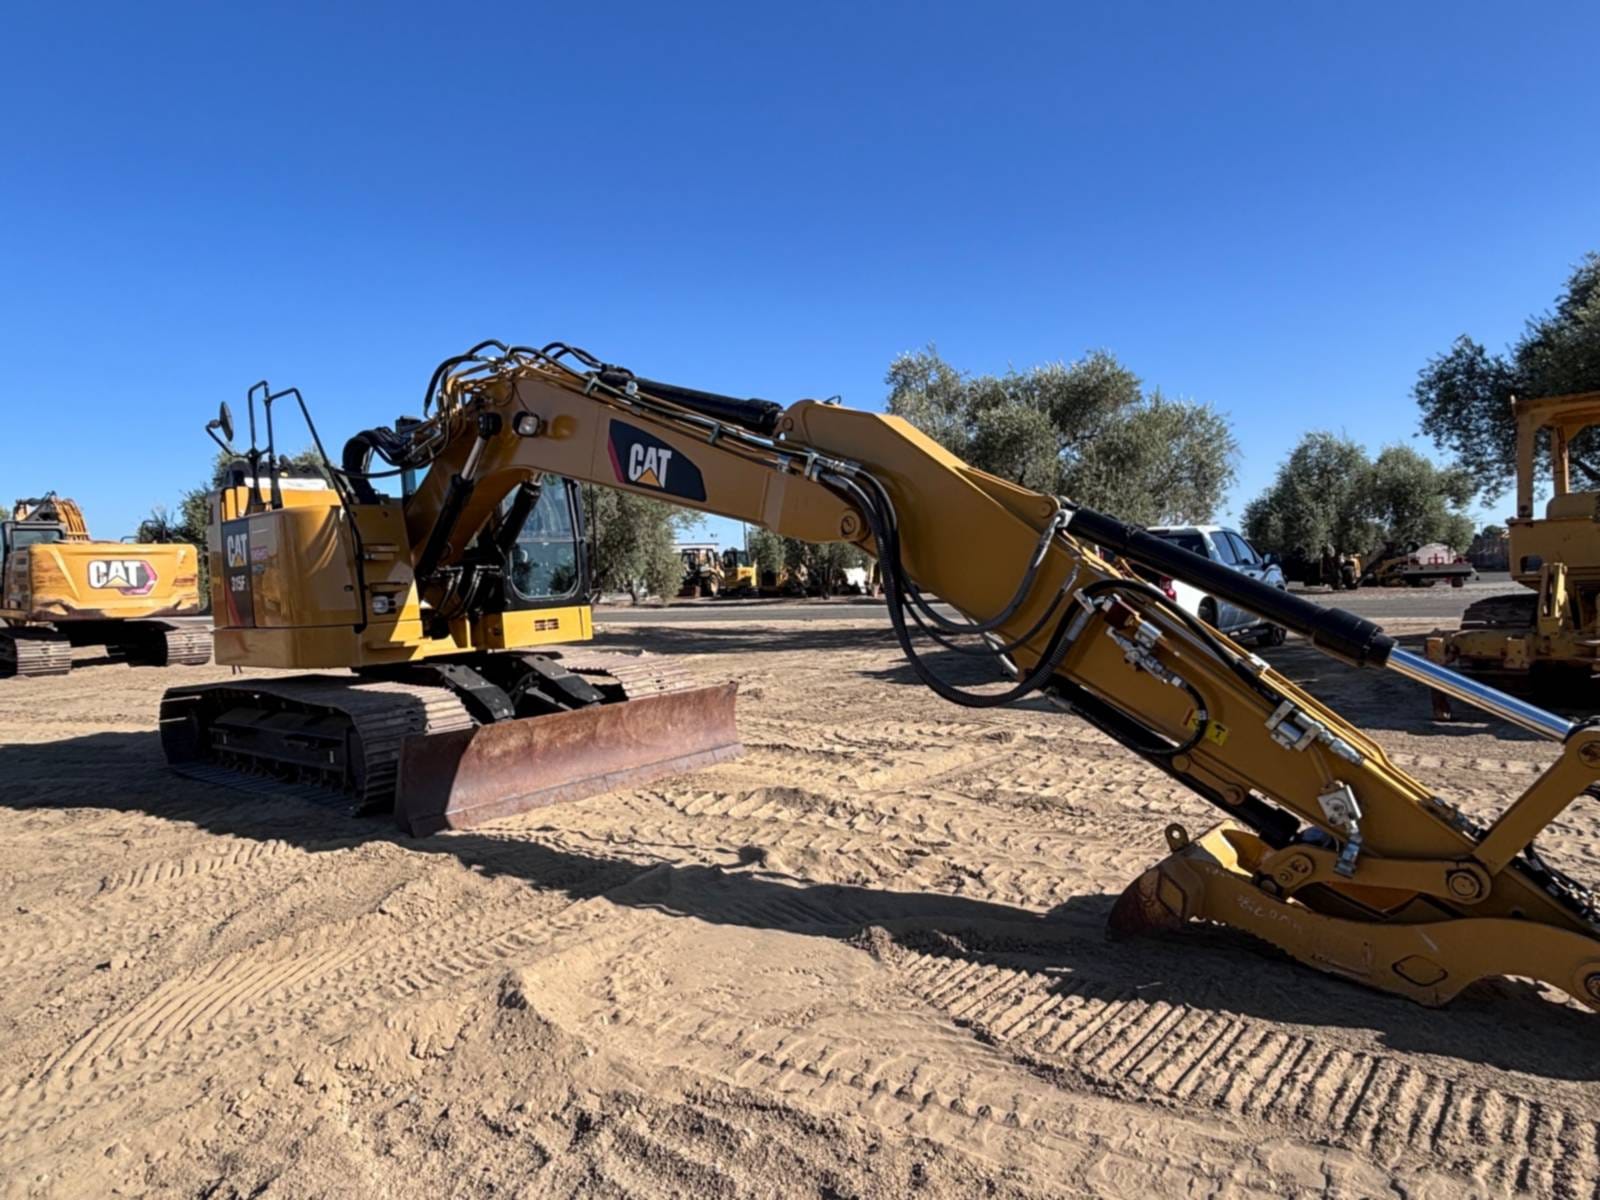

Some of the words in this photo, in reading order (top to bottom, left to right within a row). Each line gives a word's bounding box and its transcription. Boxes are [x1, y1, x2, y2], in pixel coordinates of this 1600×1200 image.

[628, 443, 672, 488] CAT
[227, 533, 247, 567] CAT
[89, 561, 141, 588] CAT
